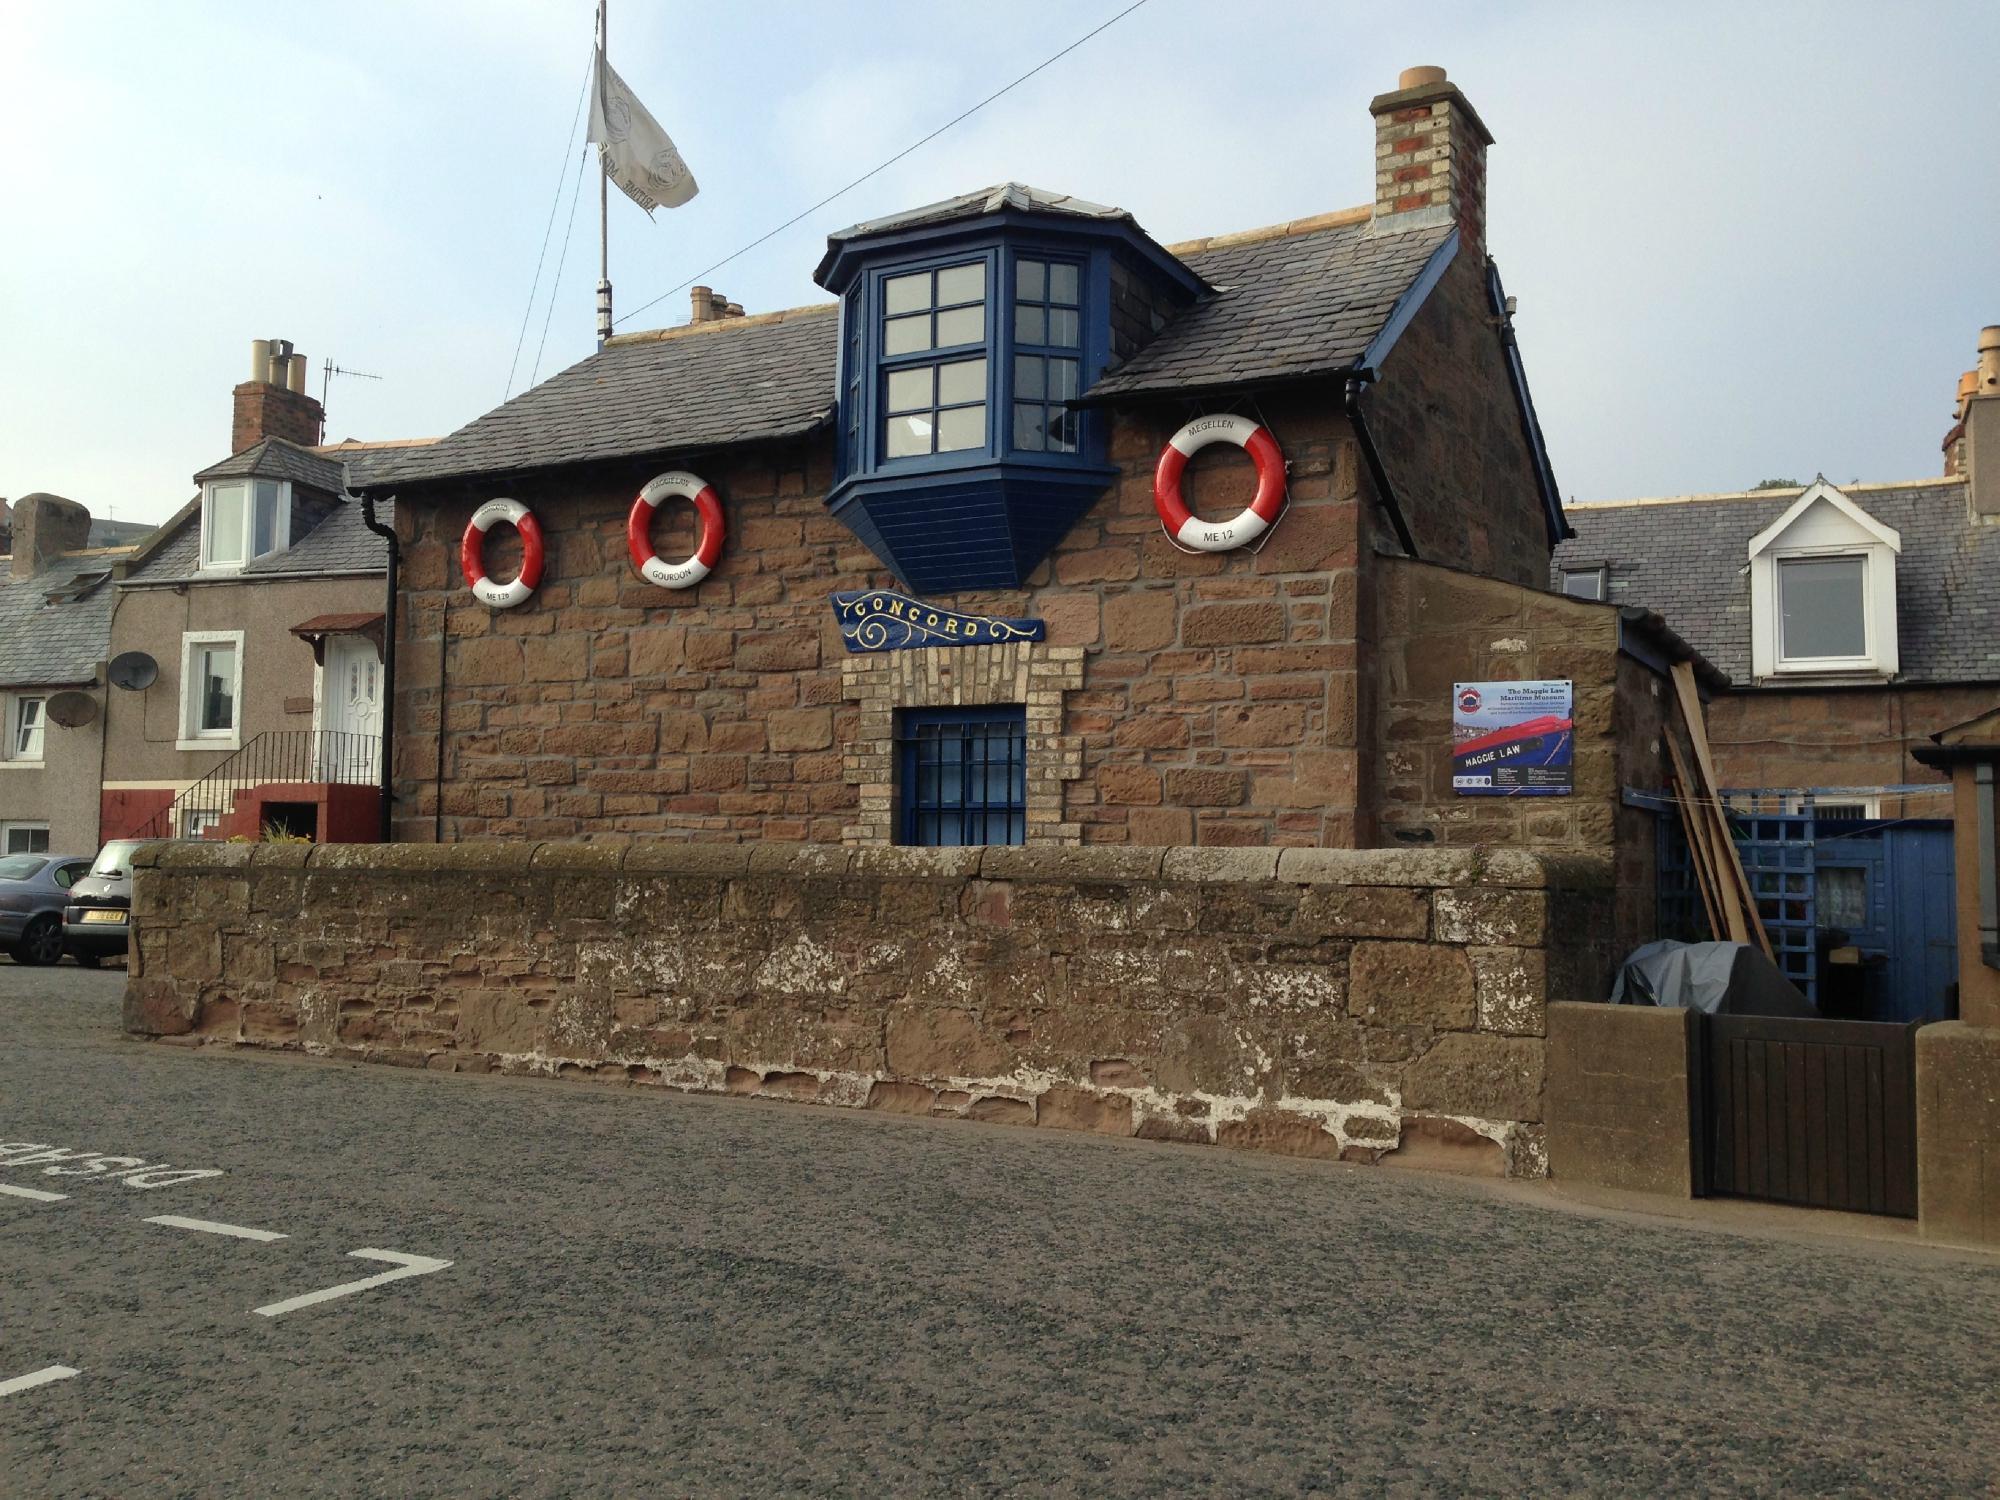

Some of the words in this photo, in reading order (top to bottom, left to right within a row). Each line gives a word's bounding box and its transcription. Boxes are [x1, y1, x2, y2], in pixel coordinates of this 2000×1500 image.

[1188, 419, 1234, 437] MEGELLEN
[1203, 532, 1220, 542] ME
[1222, 529, 1234, 540] 12
[652, 568, 692, 582] GOURDON
[486, 592, 496, 601] ME
[854, 597, 978, 637] CONCORD
[1465, 752, 1496, 767] MAGGIE
[1499, 745, 1520, 758] LAW
[0, 1138, 224, 1188] DISAB
